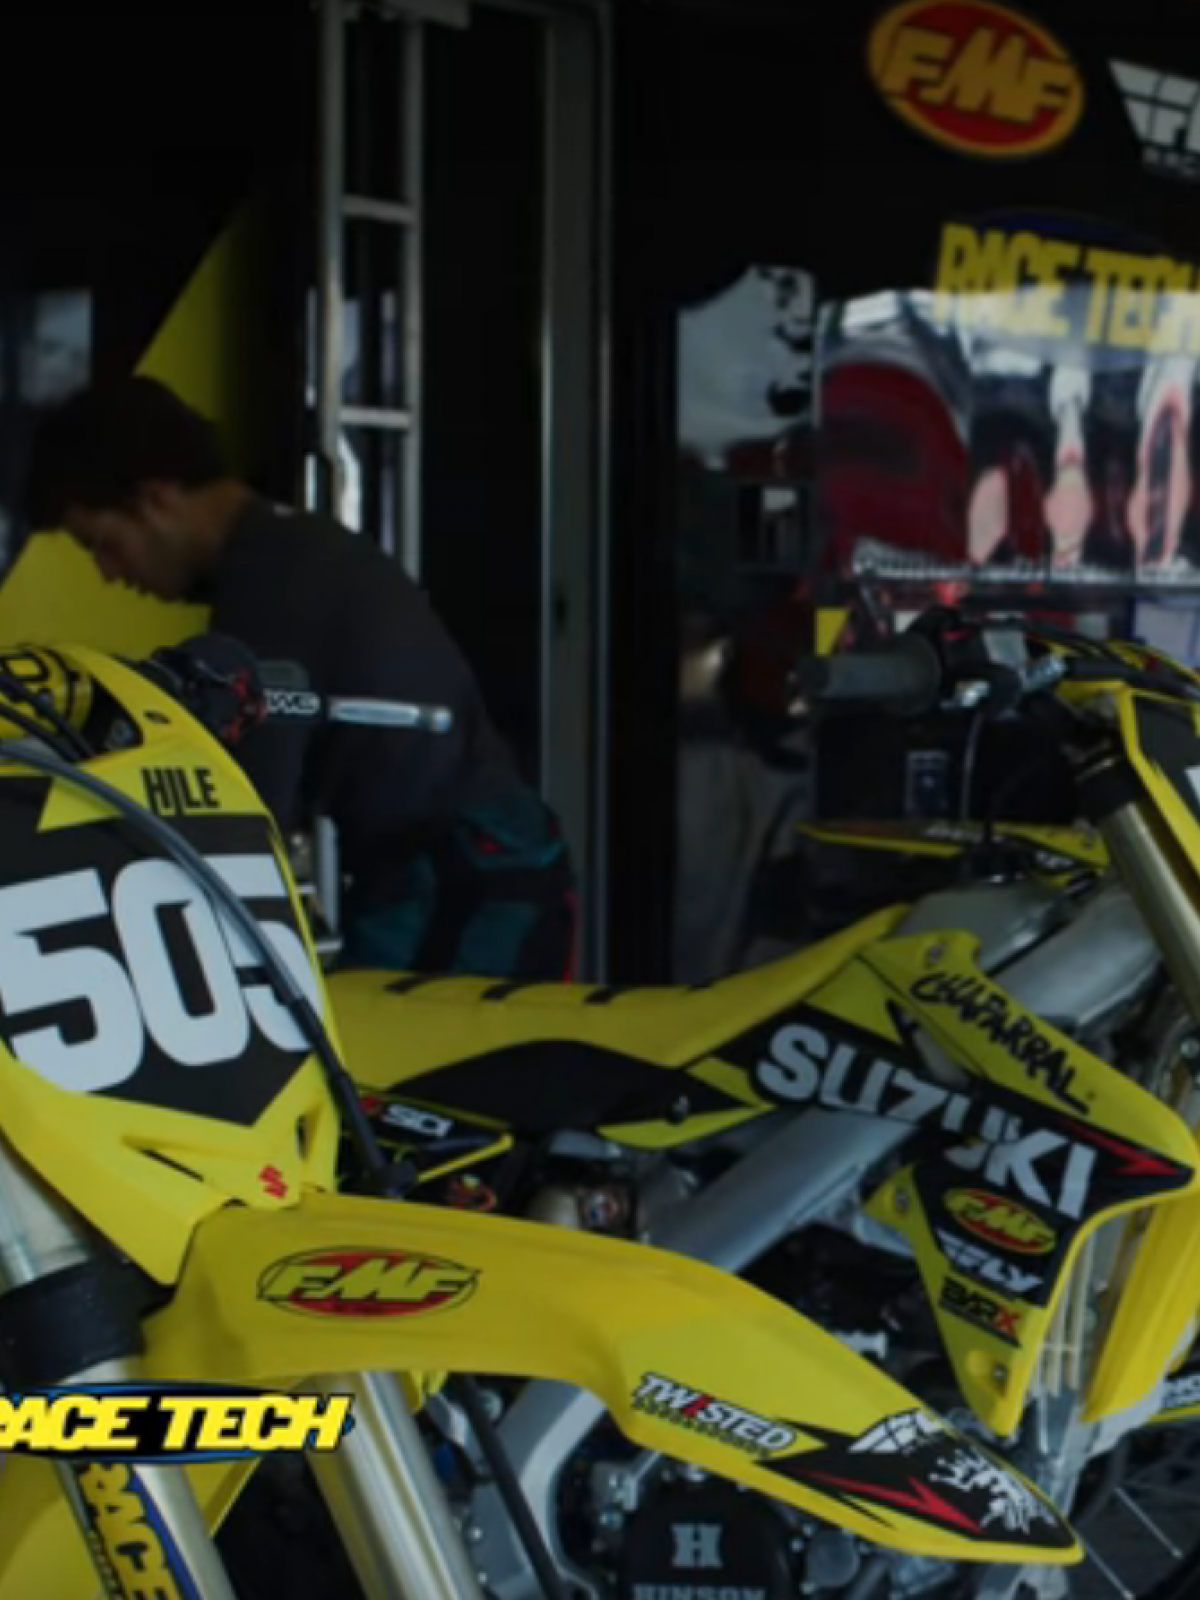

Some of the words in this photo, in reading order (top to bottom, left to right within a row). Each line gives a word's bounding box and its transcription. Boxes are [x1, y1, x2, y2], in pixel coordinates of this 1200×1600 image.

[880, 26, 1080, 124] FMF
[933, 222, 1080, 337] RACE
[141, 767, 220, 816] HILE
[0, 855, 325, 1094] 505
[909, 972, 1091, 1115] CHAPARRAL
[755, 1024, 1098, 1220] SUZUKI
[258, 1258, 480, 1302] FMF
[635, 1372, 796, 1450] TWISTED
[670, 1523, 724, 1567] H
